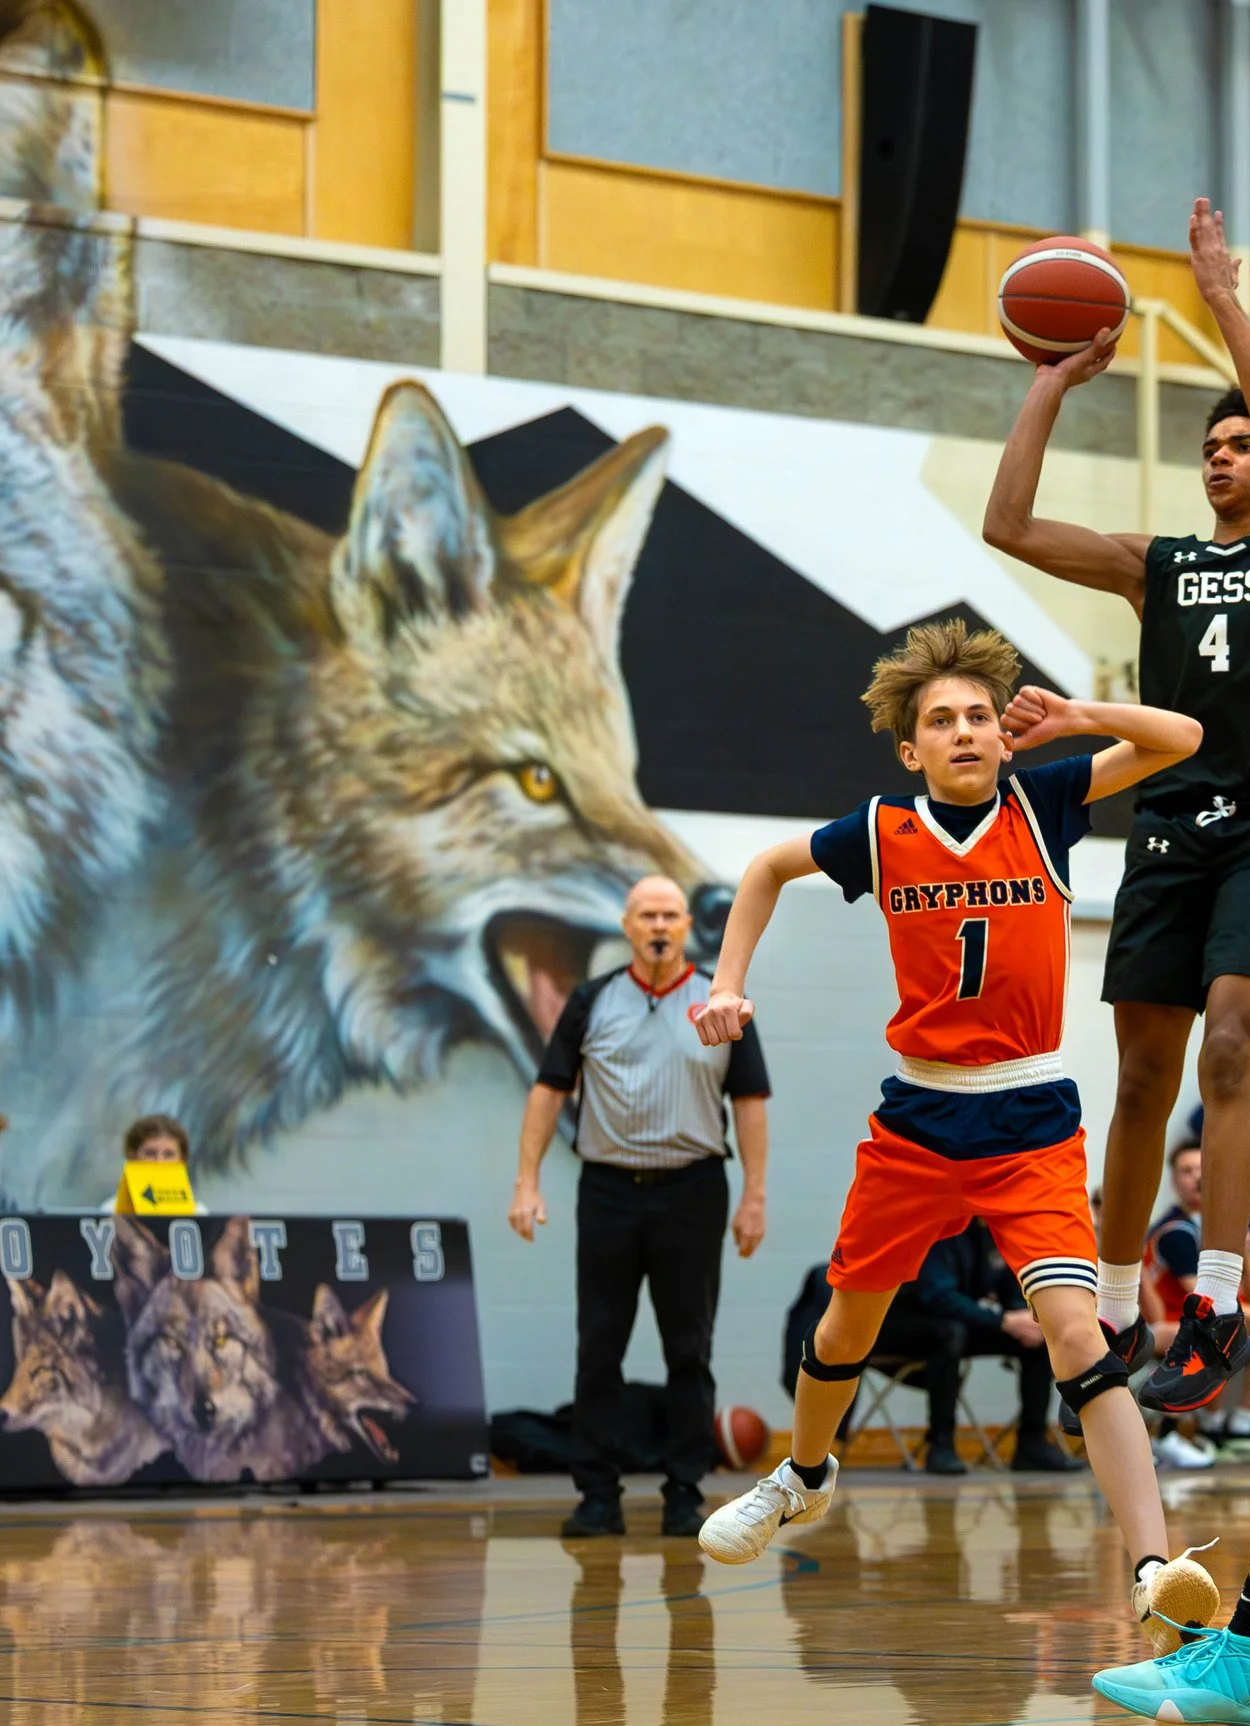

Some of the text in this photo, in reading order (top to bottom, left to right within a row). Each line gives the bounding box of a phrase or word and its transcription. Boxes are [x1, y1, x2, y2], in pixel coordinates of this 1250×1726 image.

[1198, 613, 1230, 672] 4
[889, 875, 1048, 915] GRYPHONS
[954, 918, 989, 1001] 1
